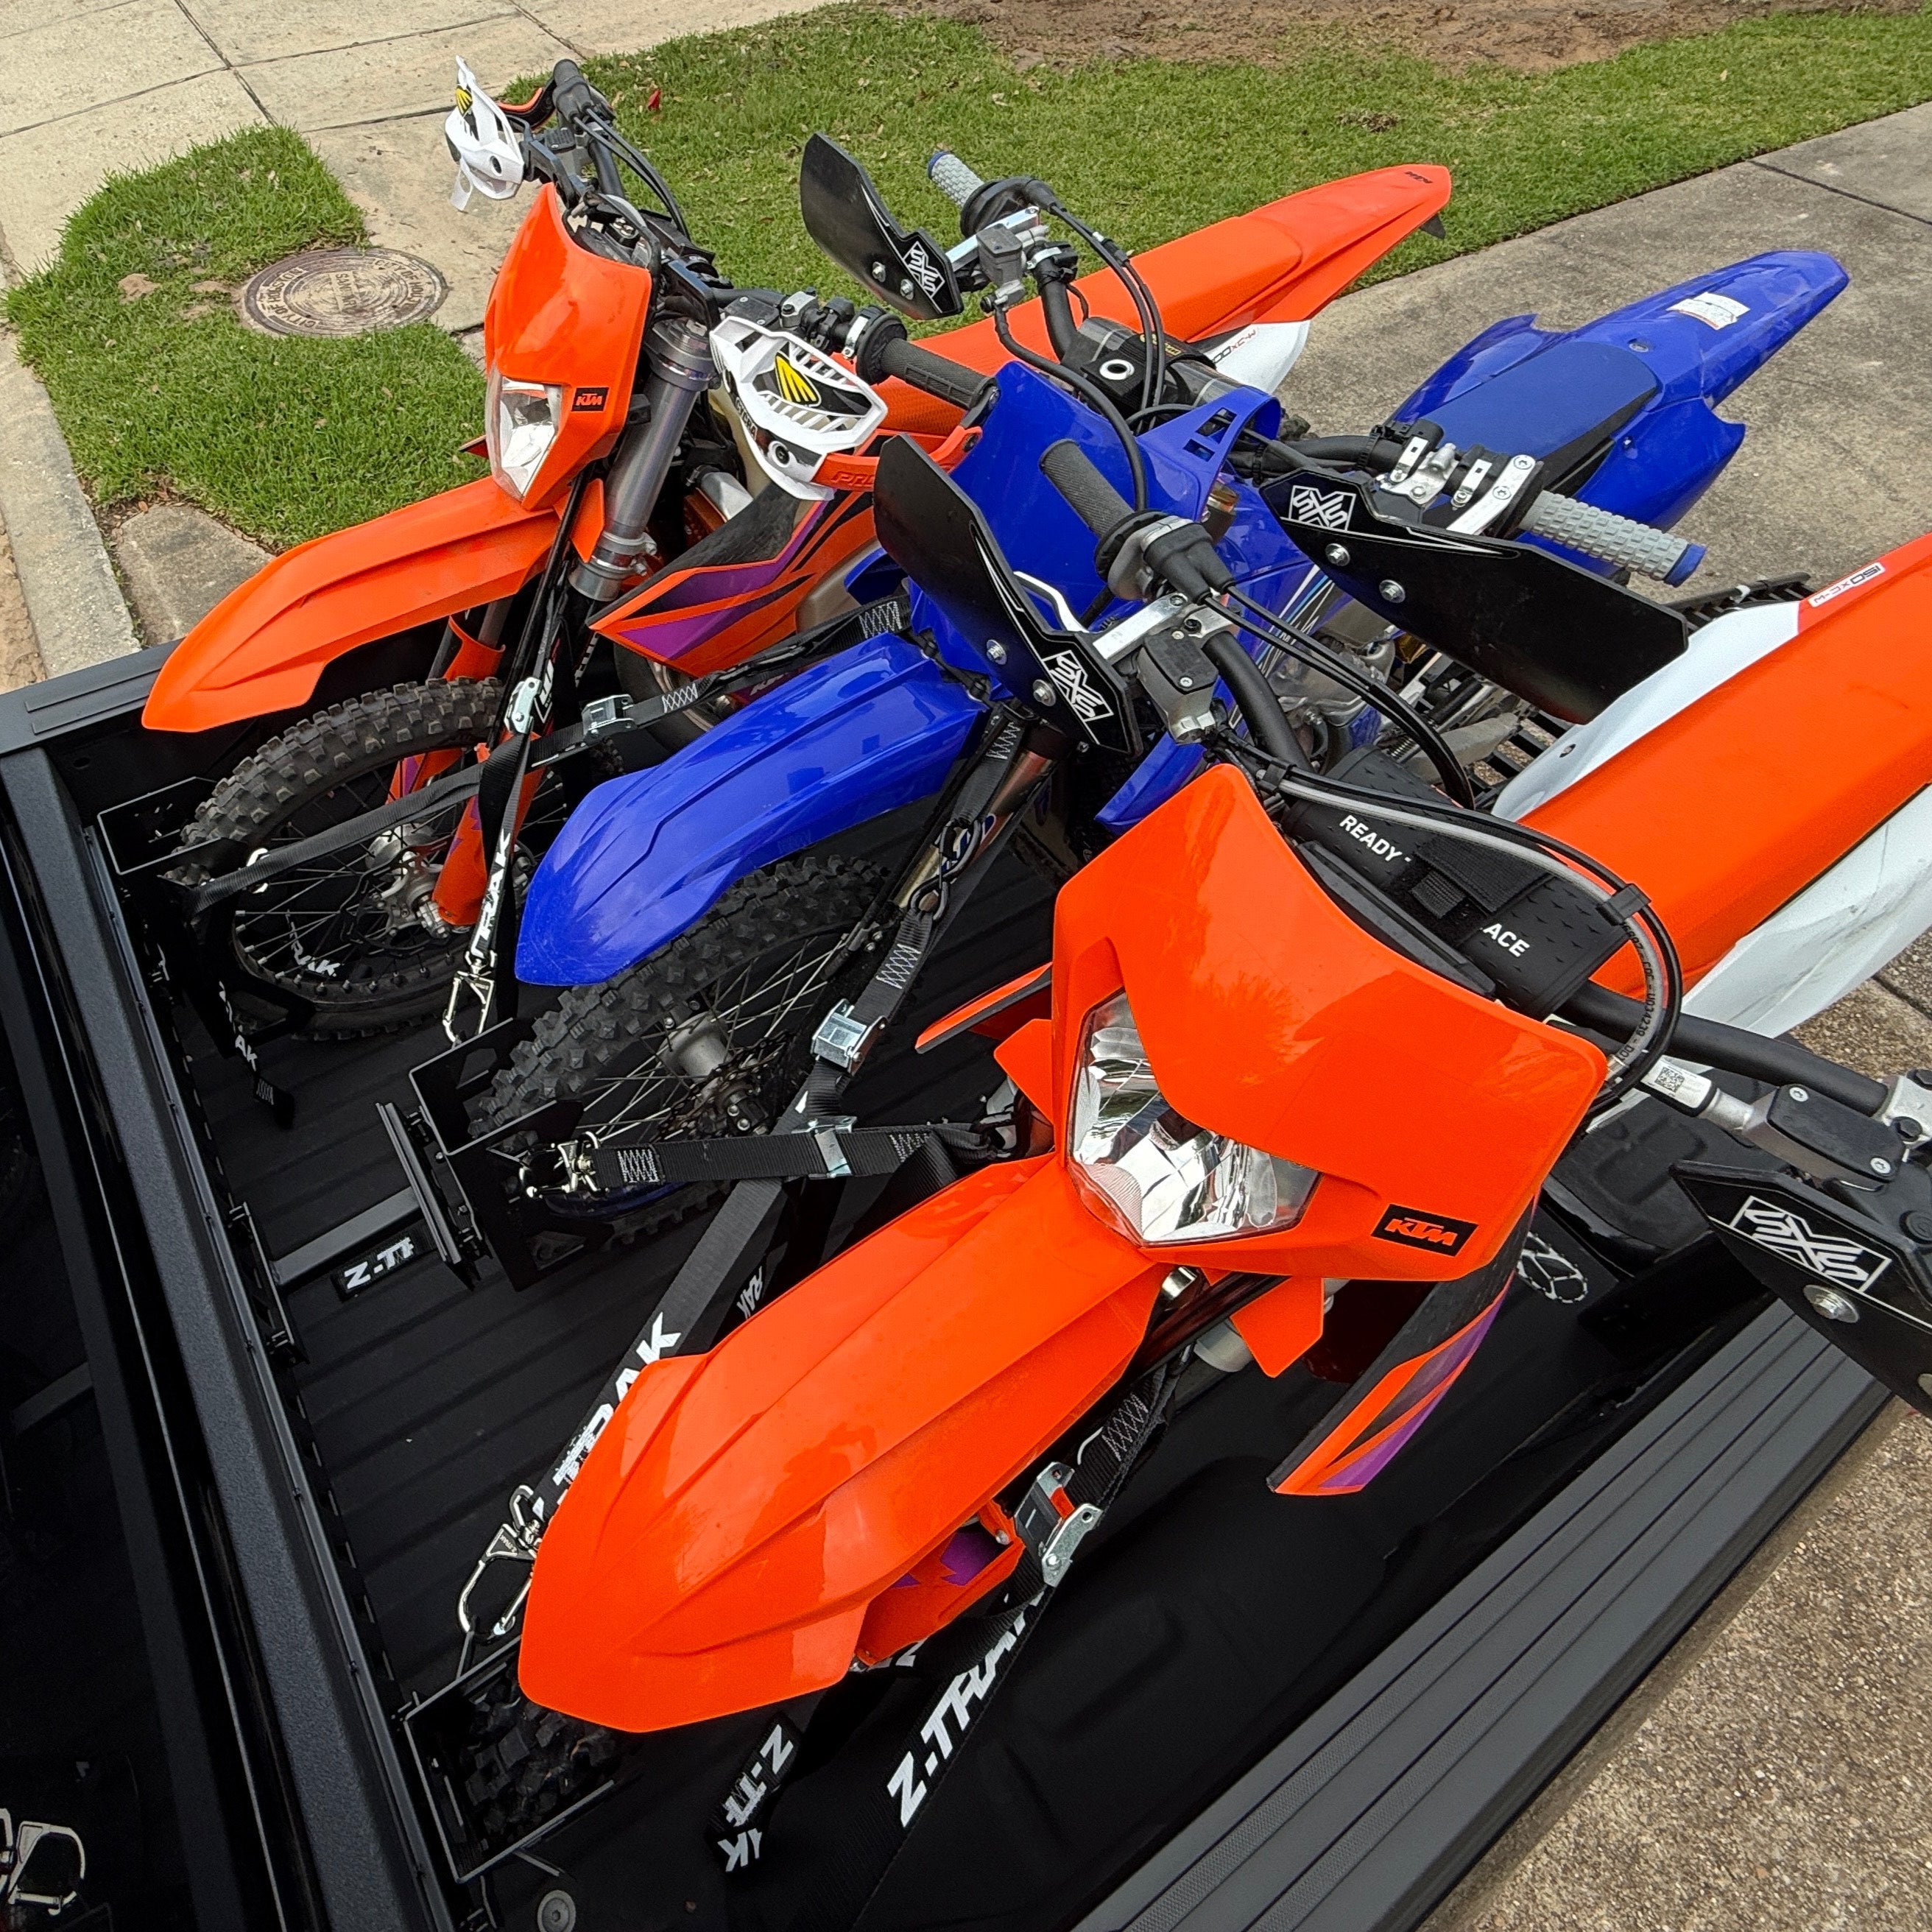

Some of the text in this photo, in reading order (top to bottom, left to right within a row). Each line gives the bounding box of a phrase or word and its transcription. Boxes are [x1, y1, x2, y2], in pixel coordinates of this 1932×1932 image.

[283, 312, 316, 328] CITY
[575, 393, 603, 406] KTM
[1339, 814, 1531, 958] READY ACE
[1384, 1217, 1458, 1247] KTM
